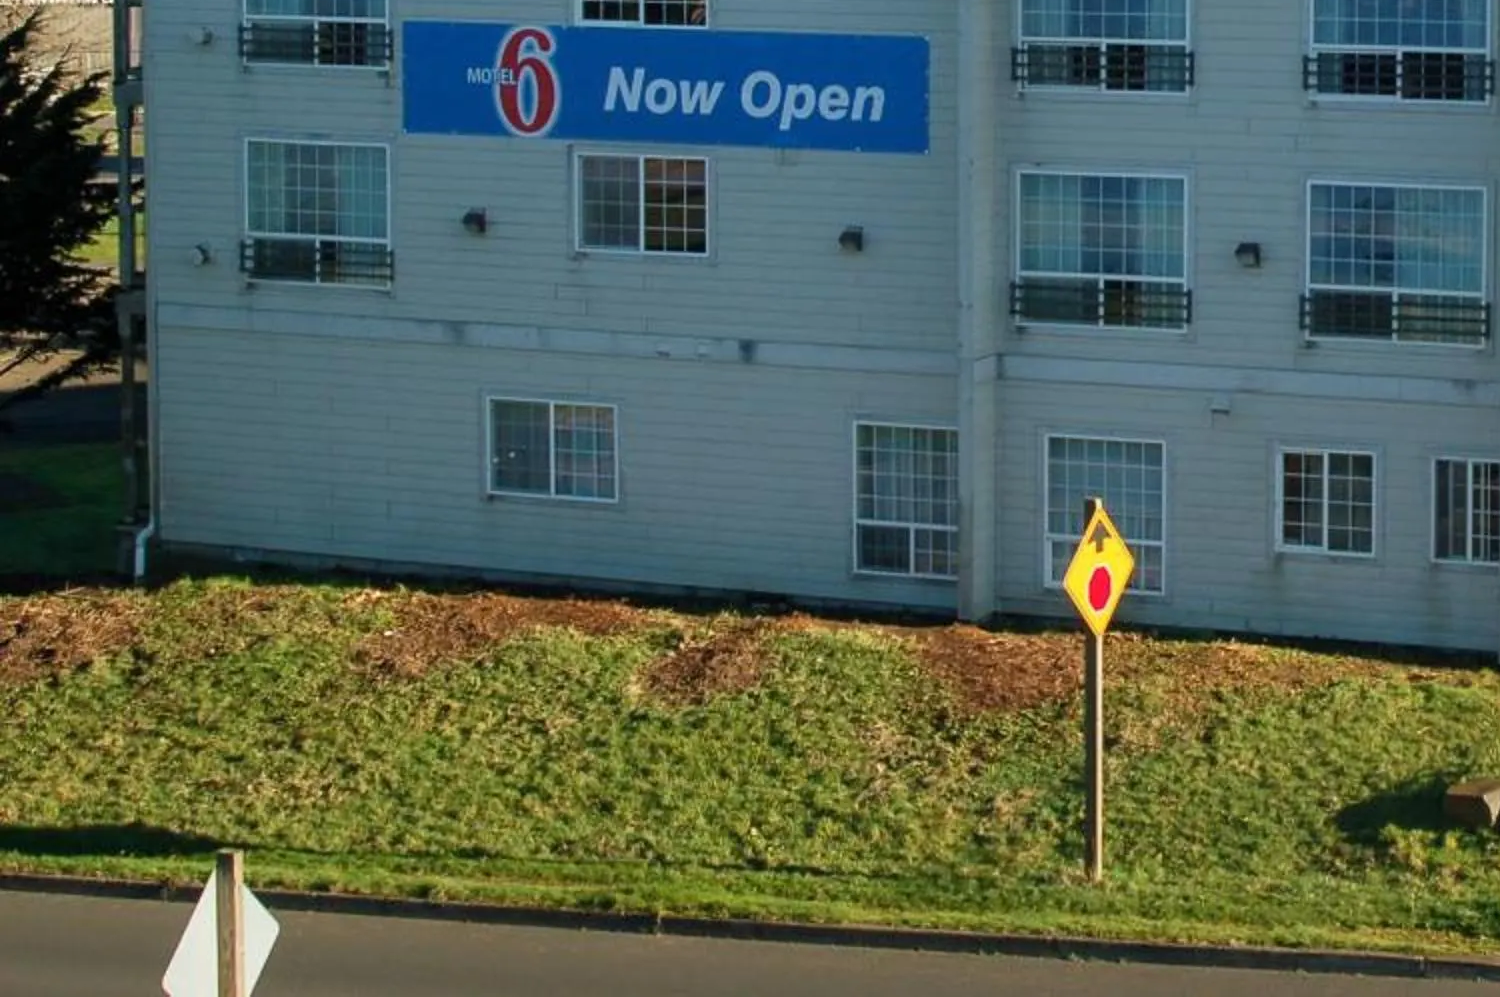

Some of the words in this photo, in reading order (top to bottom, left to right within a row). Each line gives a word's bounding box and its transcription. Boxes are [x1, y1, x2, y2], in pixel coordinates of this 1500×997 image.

[466, 67, 518, 86] MOTEL
[497, 27, 559, 135] 6
[603, 65, 726, 116] Now
[740, 70, 886, 131] Open
